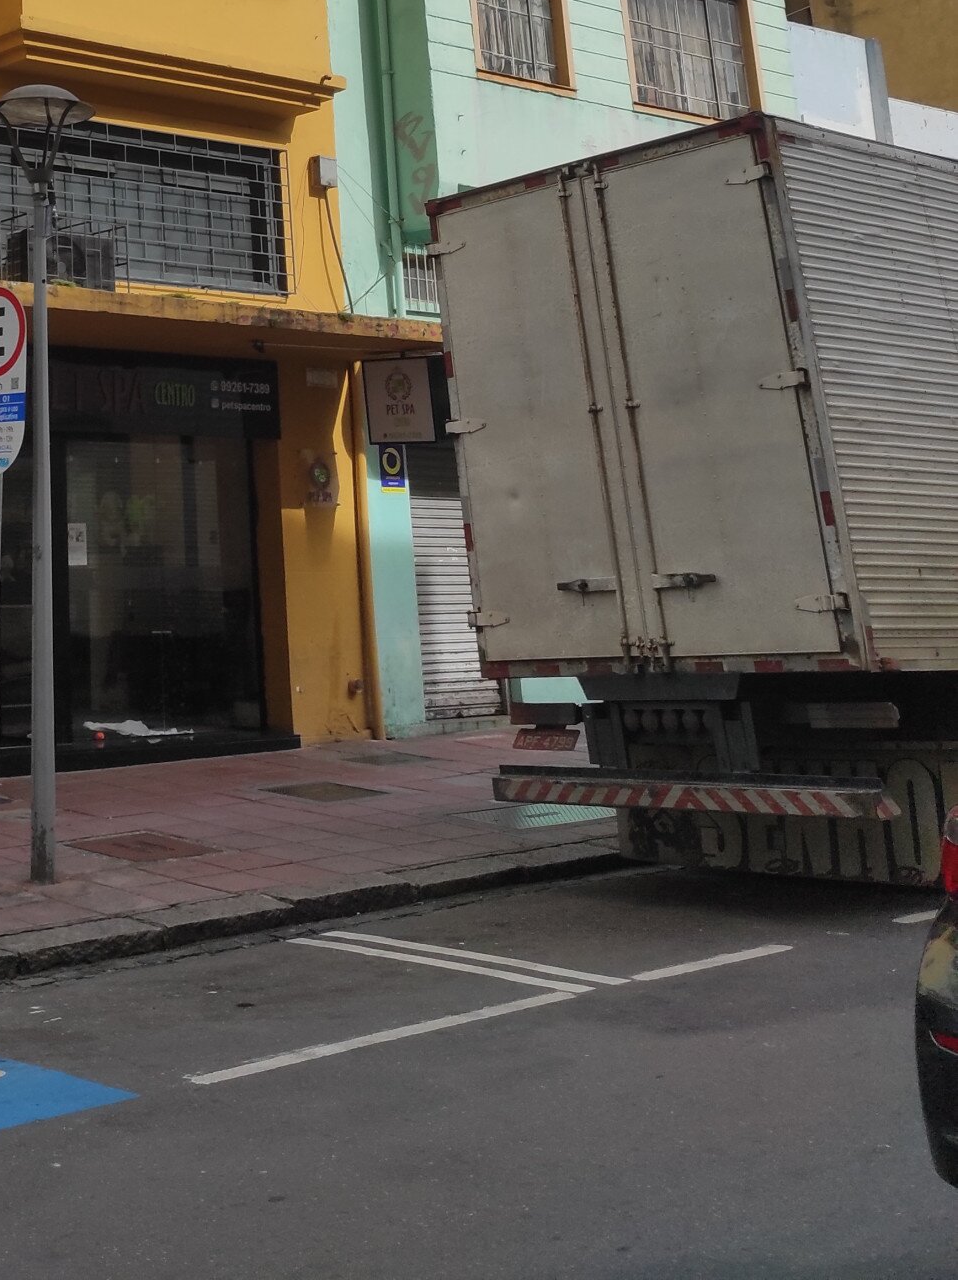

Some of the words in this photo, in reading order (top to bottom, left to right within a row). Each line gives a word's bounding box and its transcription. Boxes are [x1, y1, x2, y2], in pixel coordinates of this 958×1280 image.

[2, 395, 10, 403] 01
[155, 380, 196, 408] CENTRO
[221, 401, 271, 412] petspacentro
[386, 404, 399, 416] PET
[402, 403, 416, 415] SPA
